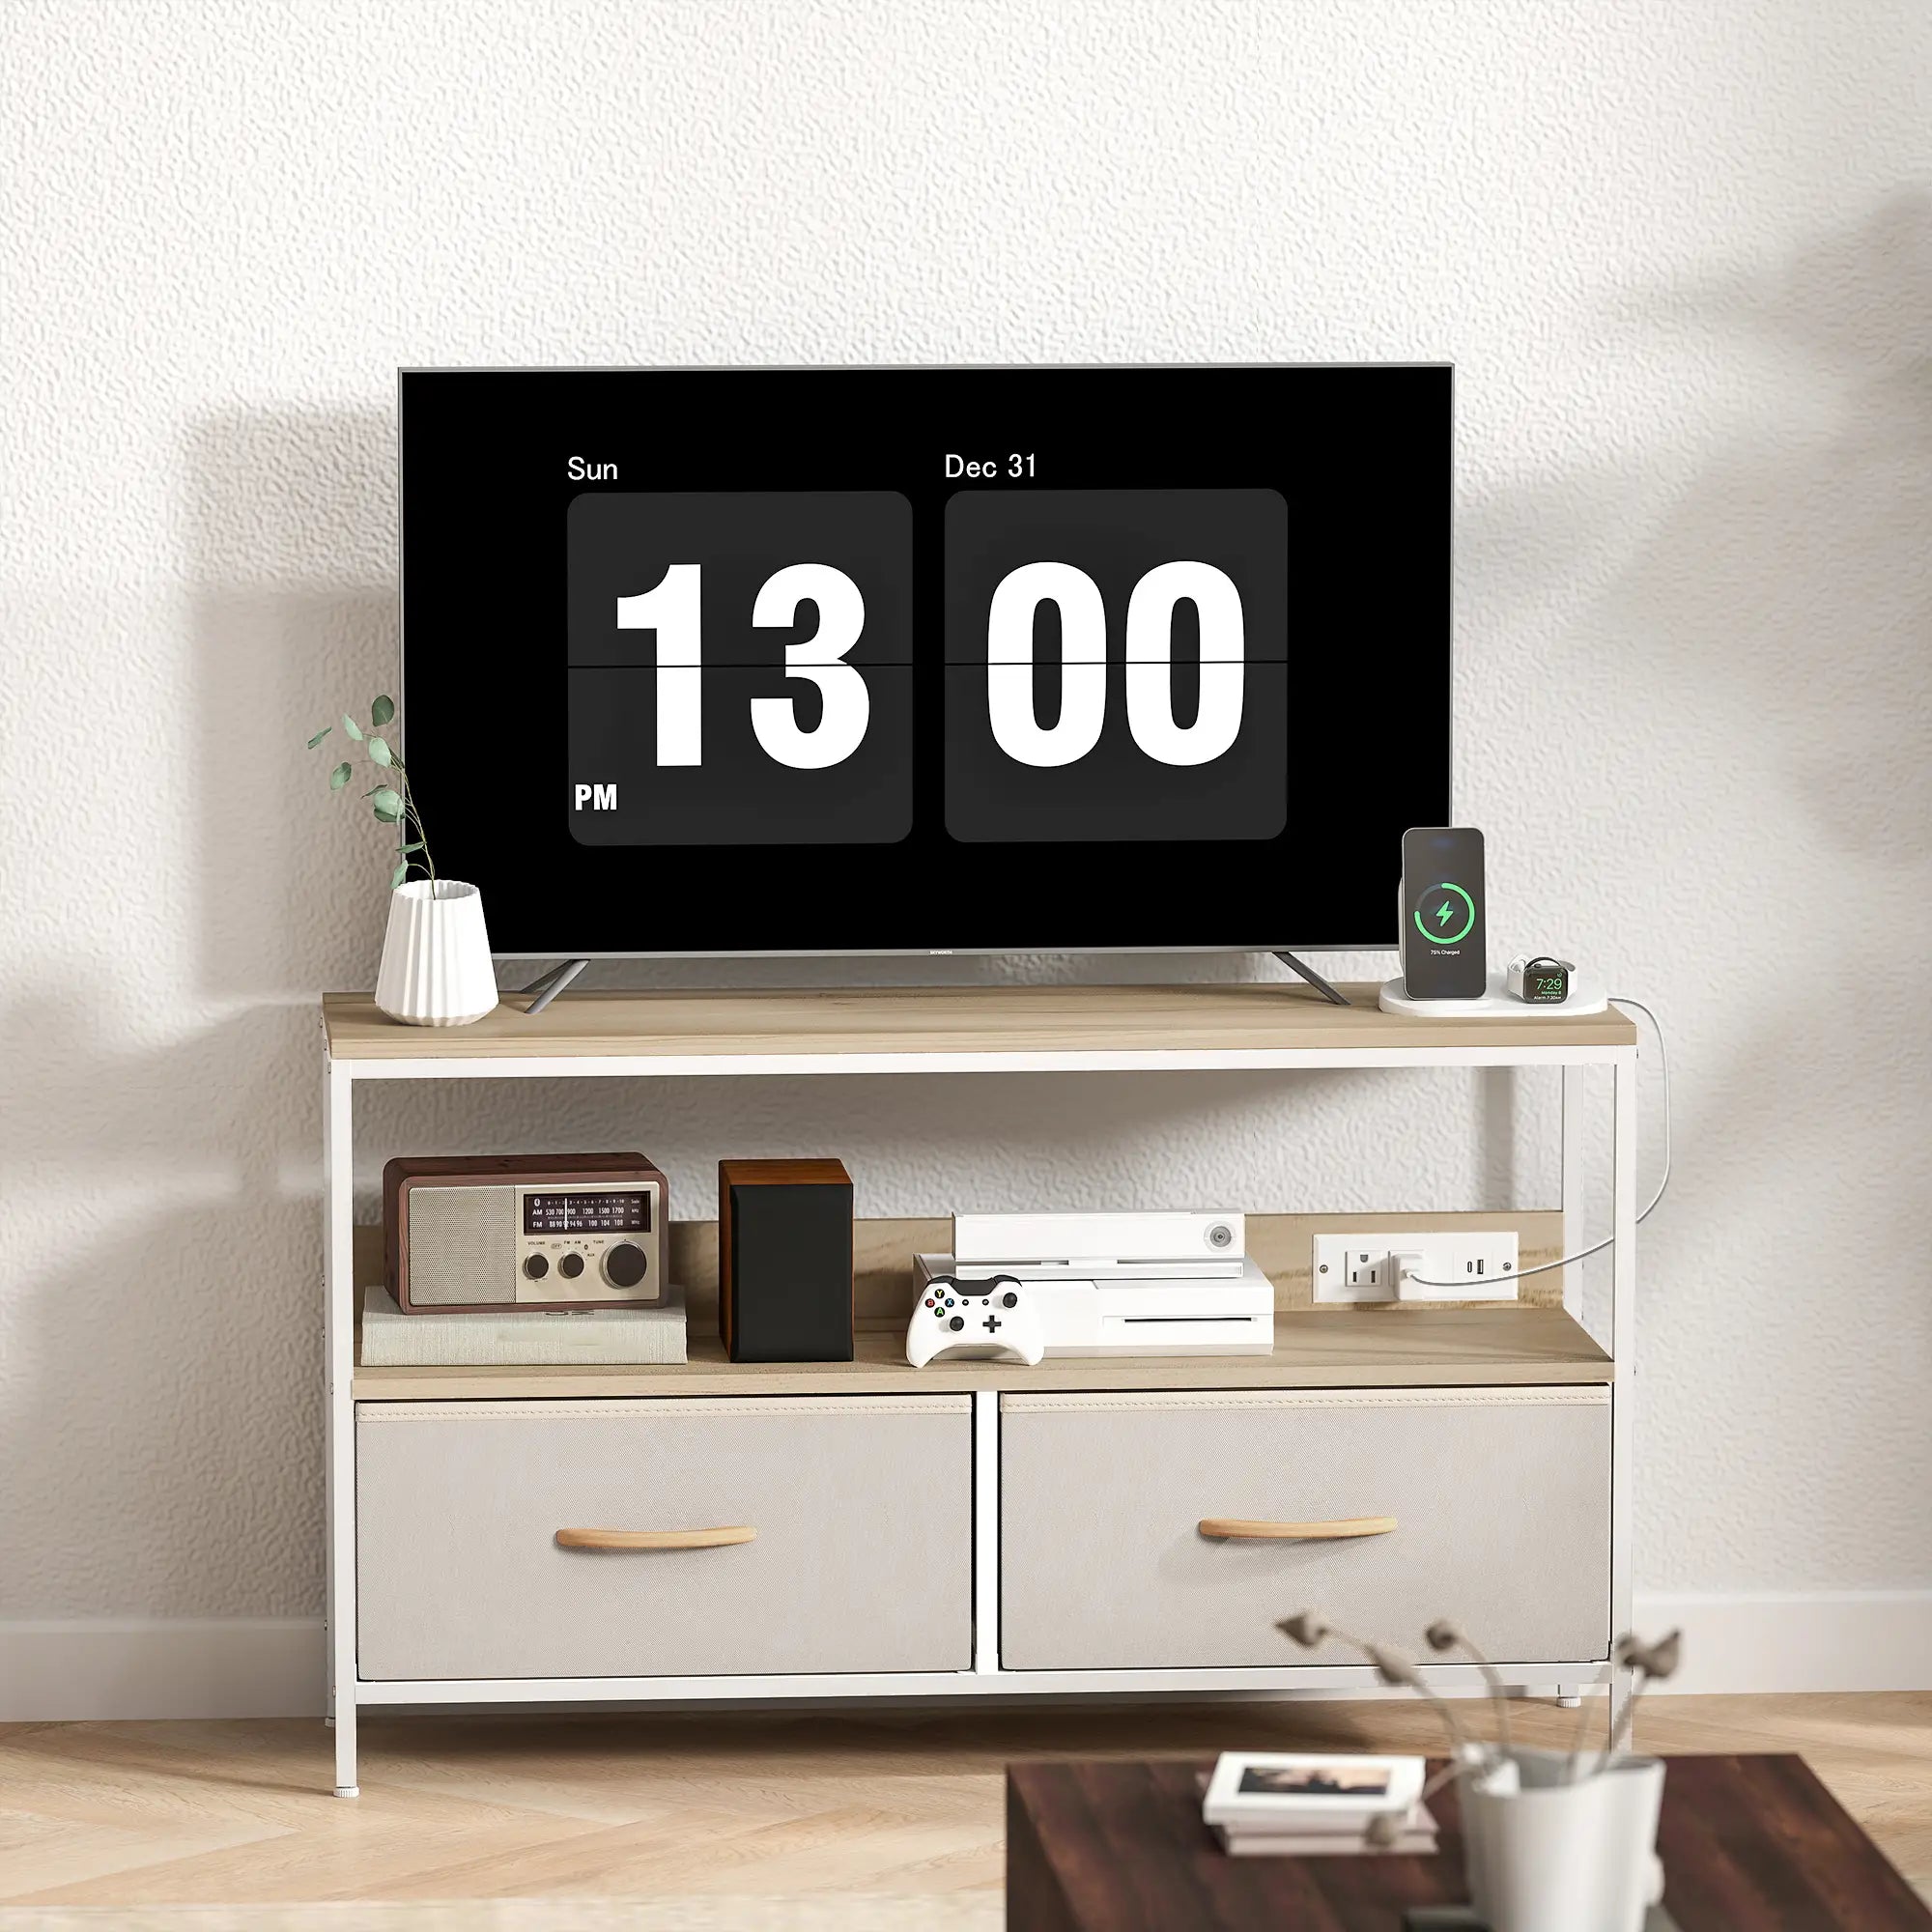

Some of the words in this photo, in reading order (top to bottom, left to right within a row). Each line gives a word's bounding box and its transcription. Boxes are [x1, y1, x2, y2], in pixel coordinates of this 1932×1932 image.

[567, 456, 618, 481] Sun
[945, 454, 998, 478] Dec
[1008, 453, 1036, 478] 31
[616, 563, 870, 769] 13
[987, 560, 1245, 768] 00
[575, 783, 617, 811] PM
[1536, 978, 1562, 990] 7:29
